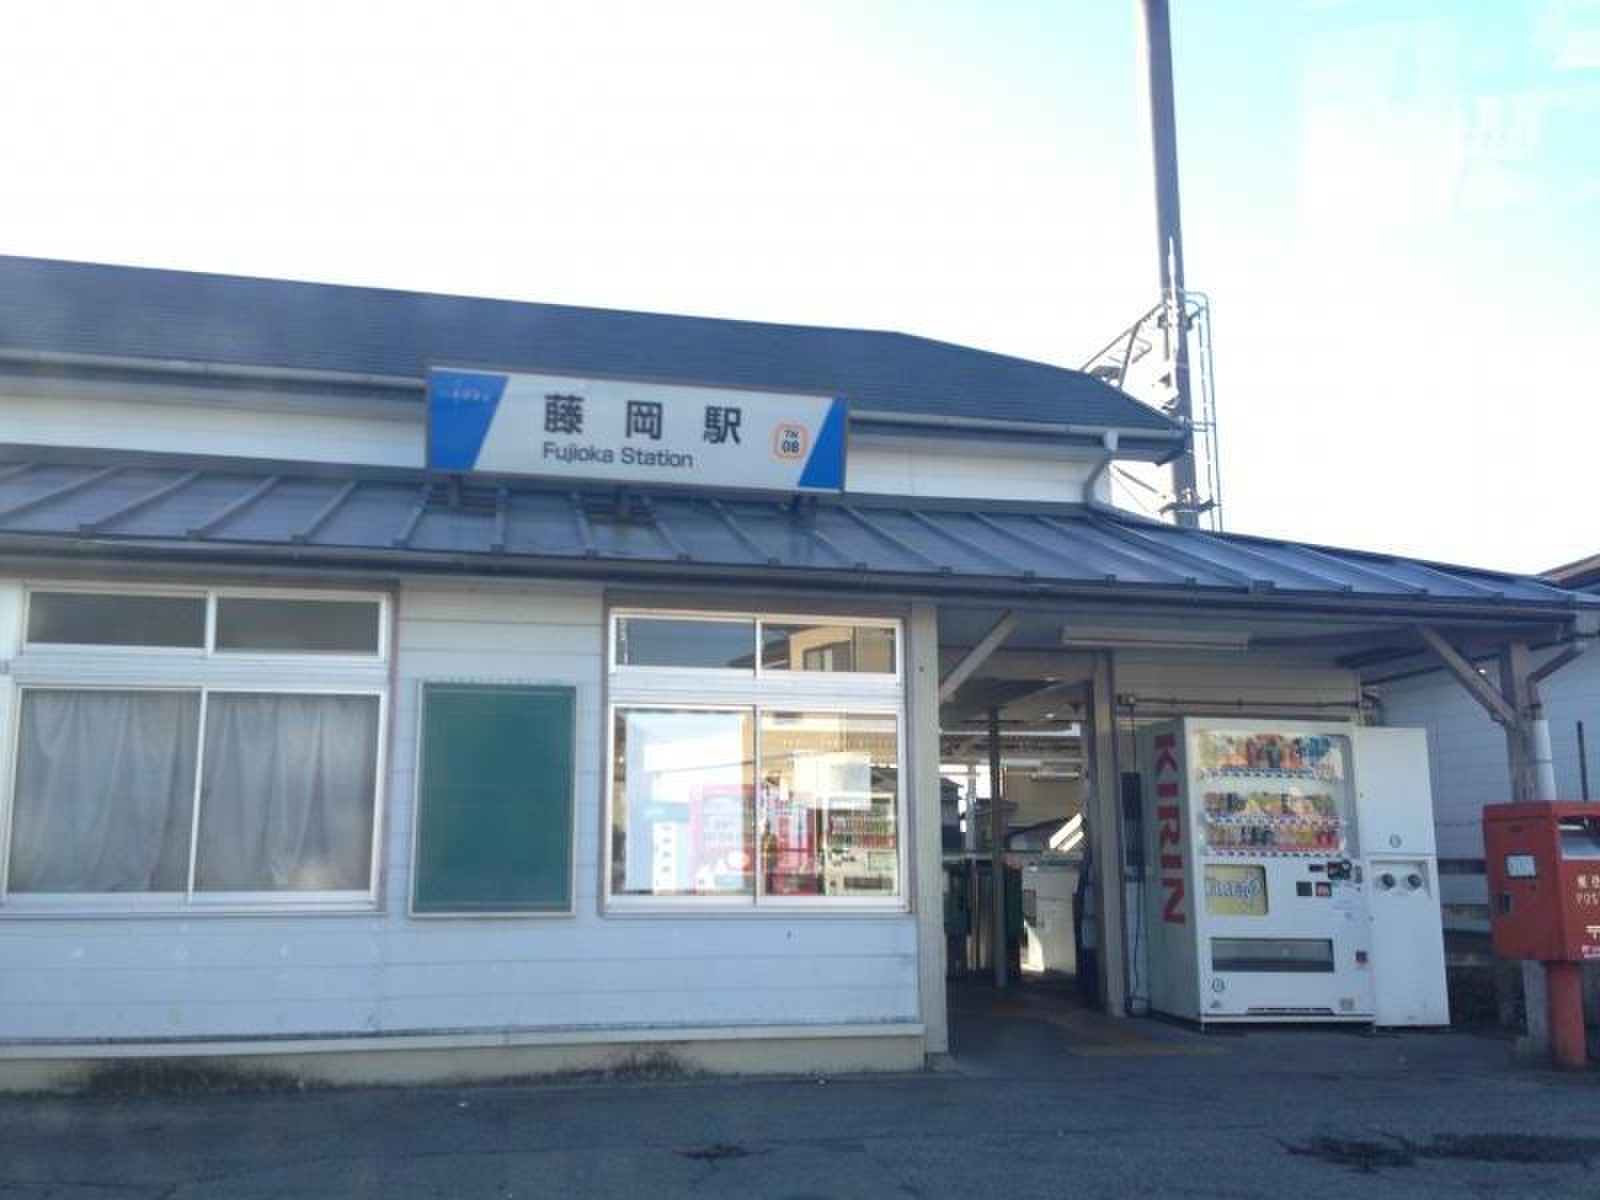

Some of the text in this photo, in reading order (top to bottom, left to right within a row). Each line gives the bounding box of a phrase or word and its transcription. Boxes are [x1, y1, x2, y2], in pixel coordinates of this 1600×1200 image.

[544, 394, 742, 445] 藤岡駅
[543, 441, 694, 468] Fujioka Station
[782, 439, 800, 453] 08
[1154, 733, 1186, 927] KIRIN
